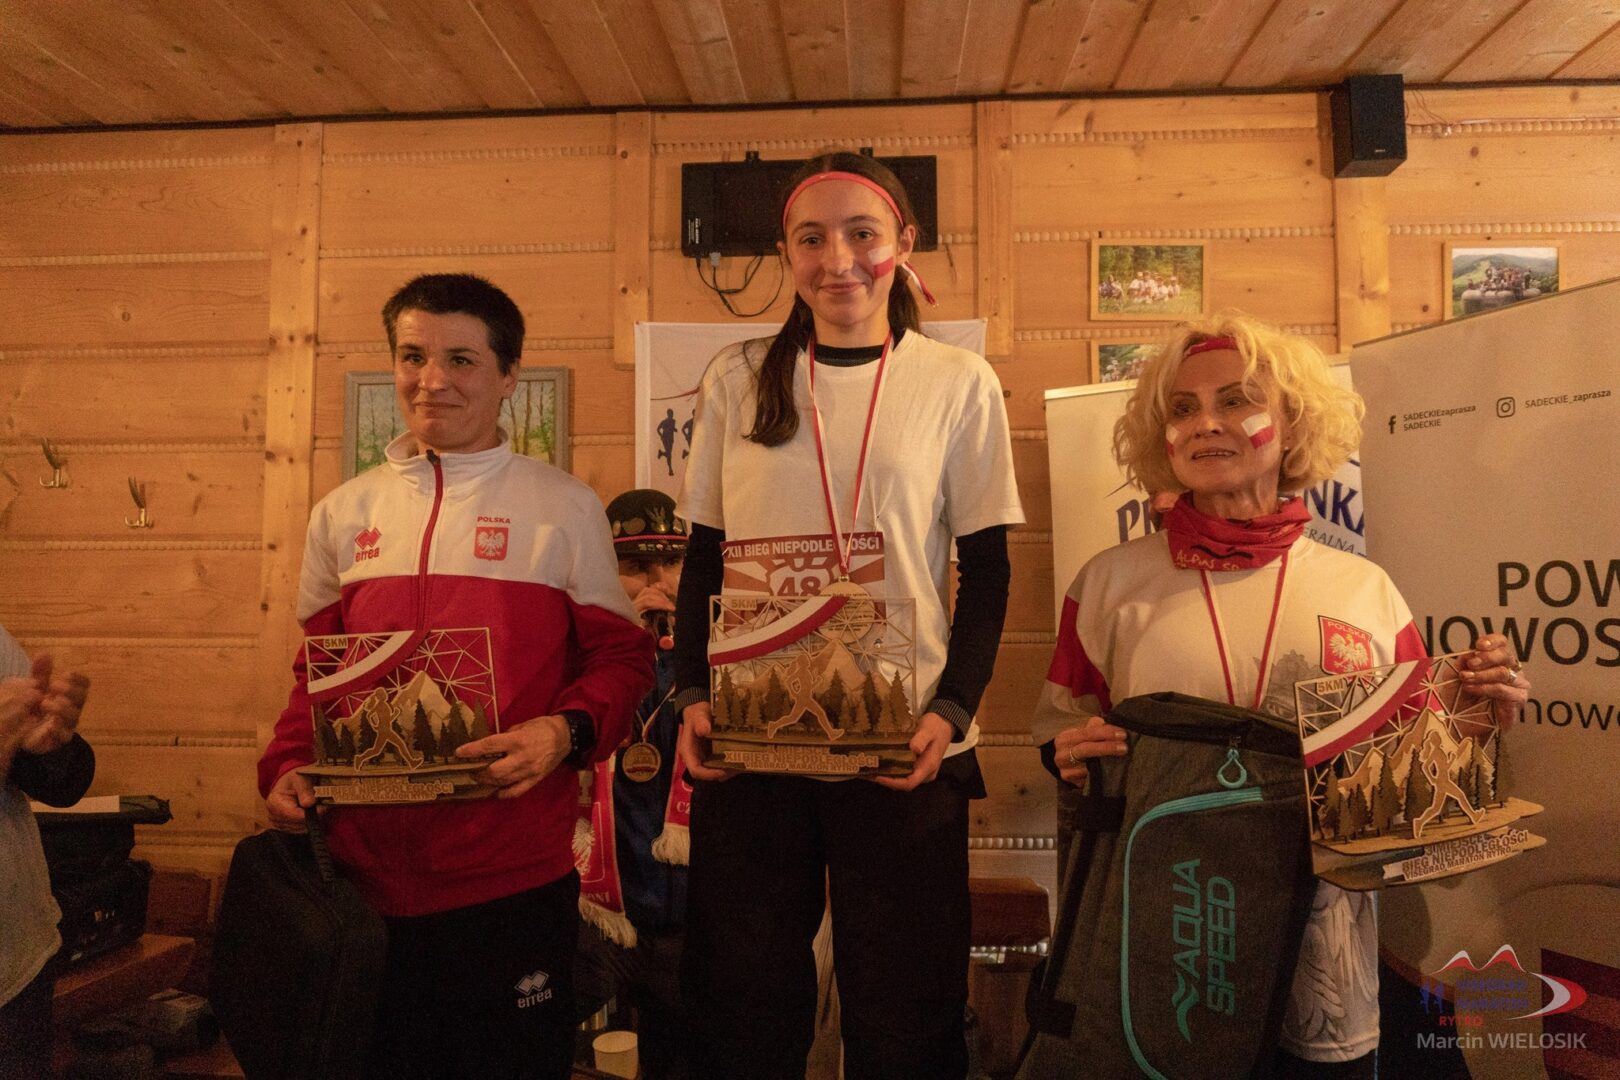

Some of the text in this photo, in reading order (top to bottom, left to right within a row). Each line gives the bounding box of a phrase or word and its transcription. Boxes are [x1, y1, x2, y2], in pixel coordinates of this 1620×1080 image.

[1403, 405, 1476, 422] SADECKIEzaprasza
[1403, 419, 1441, 432] SADECKIE
[354, 547, 380, 562] errea
[728, 534, 880, 558] XII BIEG NIEPODLEOŚCI
[777, 575, 821, 597] 48
[730, 599, 756, 609] 5KM
[1327, 621, 1366, 639] POLSKA
[324, 638, 348, 648] 5KM
[1318, 679, 1344, 693] 5KM
[1519, 698, 1620, 731] now
[1402, 858, 1429, 871] BIEG
[1172, 858, 1204, 979] AQUA
[1206, 876, 1236, 1016] SPEED
[517, 988, 553, 1009] errea
